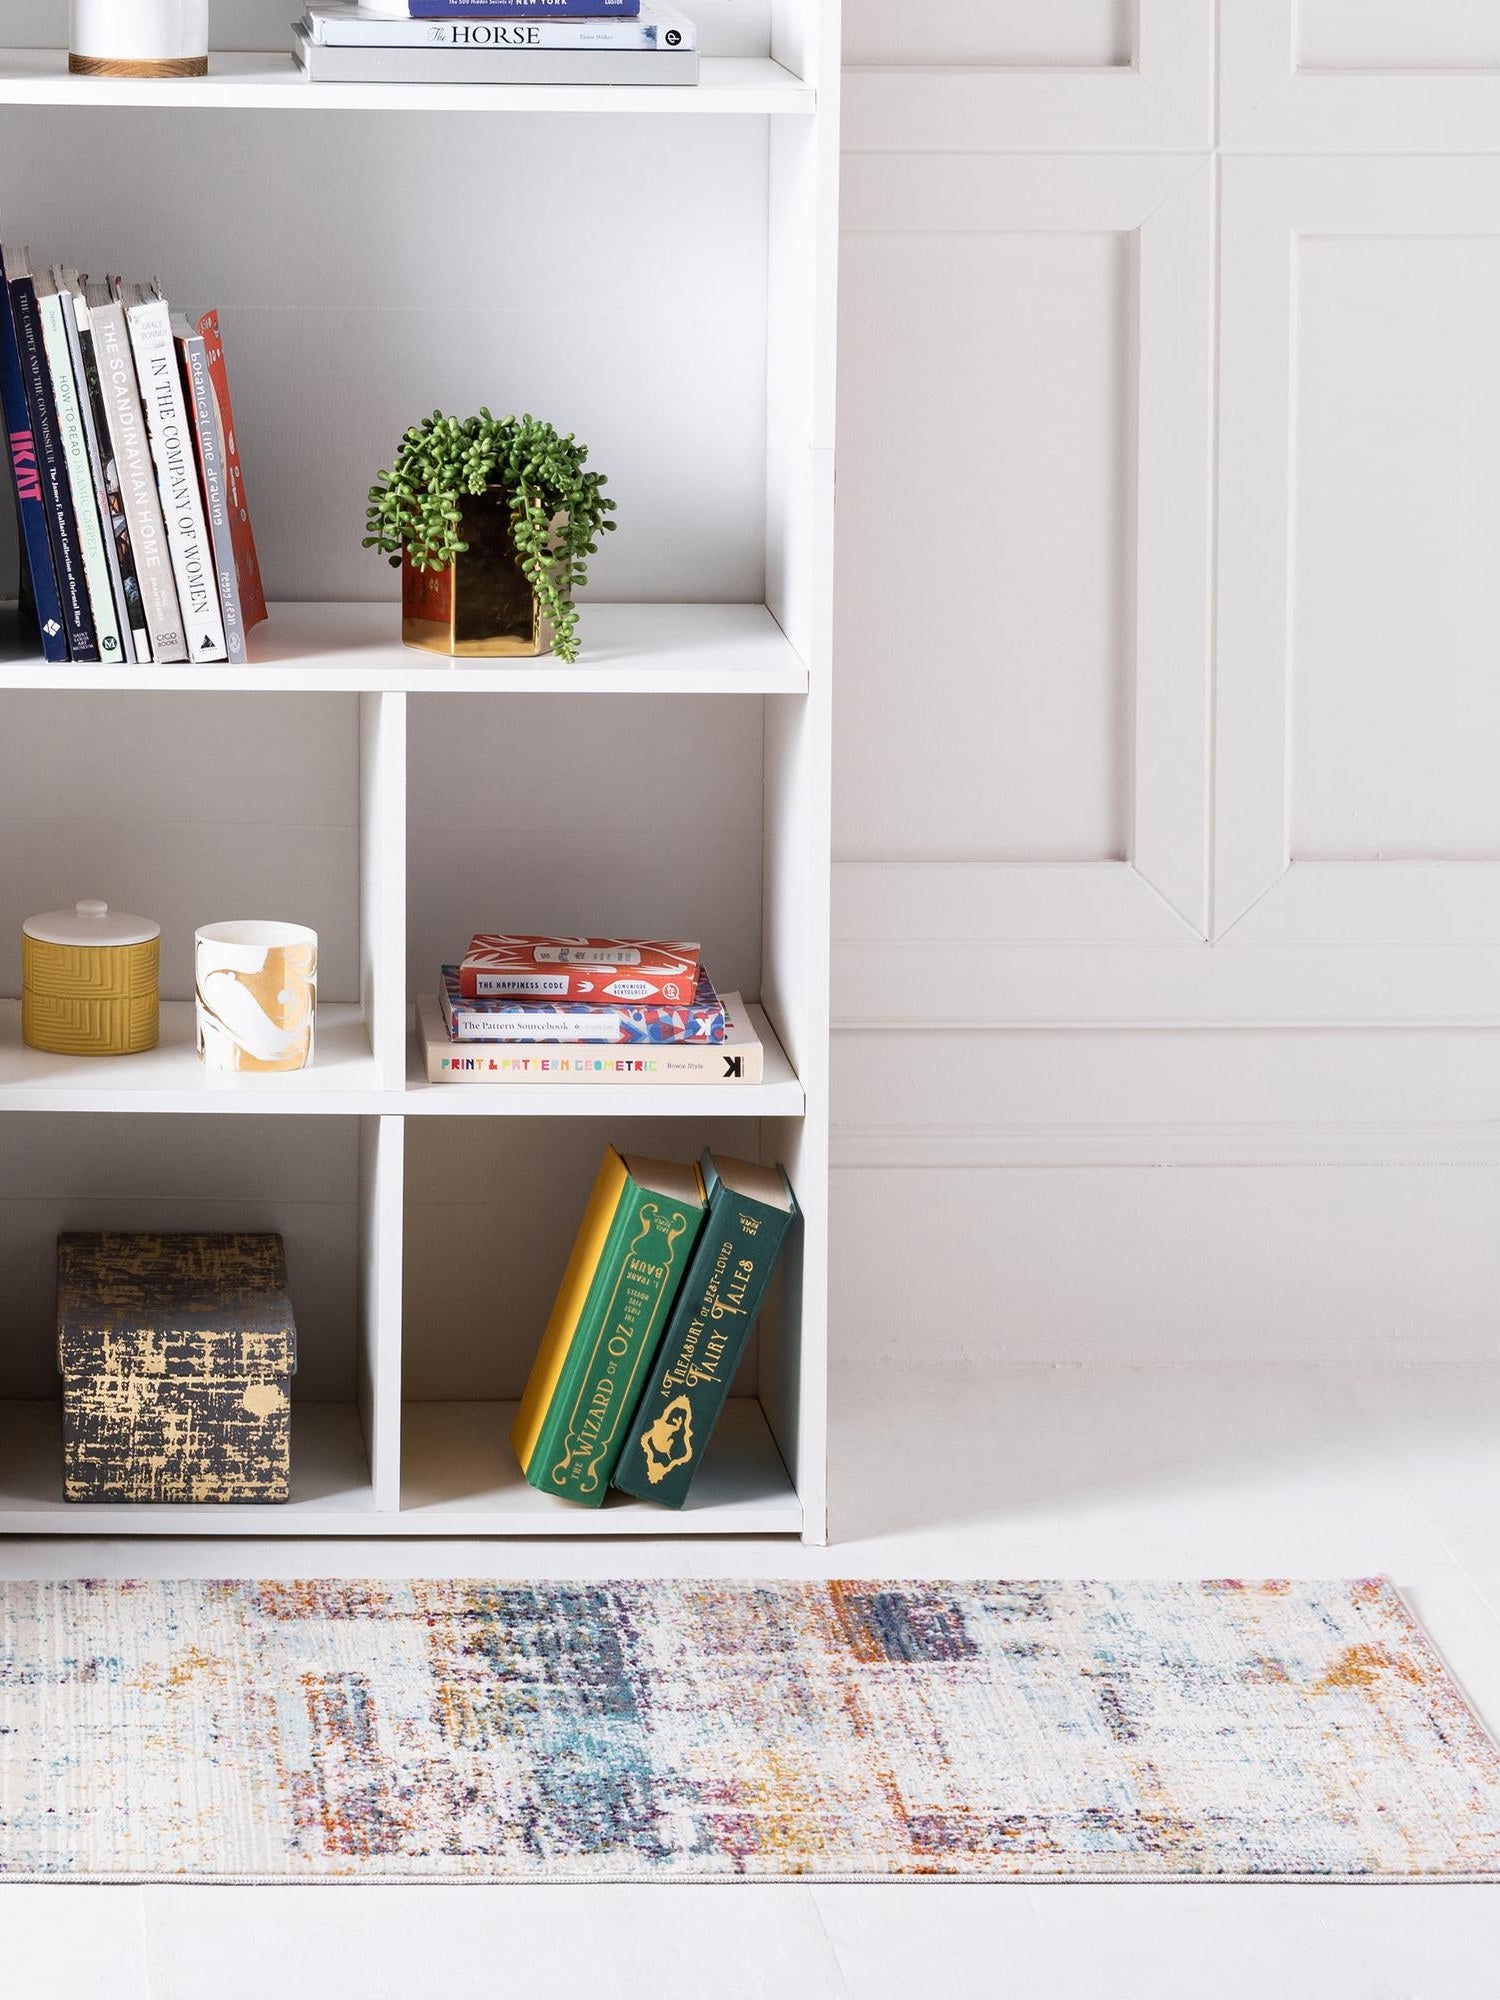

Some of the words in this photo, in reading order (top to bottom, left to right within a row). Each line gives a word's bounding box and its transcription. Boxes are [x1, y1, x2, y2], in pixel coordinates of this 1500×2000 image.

[427, 27, 447, 42] The
[451, 26, 541, 45] HORSE
[20, 292, 30, 314] THE
[23, 316, 36, 352] CARPET
[103, 322, 118, 353] THE
[29, 354, 40, 374] AND
[150, 357, 169, 376] IN
[34, 376, 43, 397] THE
[60, 375, 72, 402] HOW
[191, 352, 211, 425] botanical
[155, 381, 176, 420] THE
[65, 407, 75, 422] TO
[37, 398, 56, 464] CONNOISSEUR
[68, 426, 80, 456] READ
[110, 359, 149, 505] SCANDINAVIAN
[202, 431, 214, 461] line
[10, 430, 42, 501] IKAT
[49, 467, 58, 481] The
[162, 425, 192, 511] COMPANY
[52, 482, 60, 503] James
[73, 459, 91, 507] ISLAMIC
[207, 468, 223, 526] drawing
[57, 512, 68, 537] Ballard
[83, 511, 100, 558] CARPETS
[178, 517, 197, 539] OF
[137, 511, 160, 568] HOME
[61, 538, 72, 572] Collection
[183, 544, 210, 613] WOMEN
[221, 572, 233, 599] peggy
[69, 582, 80, 609] Oriental
[225, 601, 237, 626] dean
[157, 631, 177, 641] CICO
[158, 639, 179, 648] BOOKS
[479, 981, 493, 990] THE
[496, 981, 540, 990] HAPPINESS
[543, 982, 564, 990] CODE
[462, 1021, 480, 1030] The
[482, 1021, 515, 1031] Pattern
[517, 1021, 569, 1031] Sourcebook
[441, 1058, 484, 1071] PRINT
[488, 1058, 498, 1071] &
[502, 1059, 570, 1071] PATTERN
[574, 1060, 657, 1072] GEOMETRIC
[687, 1062, 704, 1071] Style
[626, 1272, 650, 1285] FRANK
[630, 1258, 664, 1279] BAUM
[627, 1288, 650, 1301] NOVELS
[662, 1318, 704, 1389] TREASURY
[704, 1241, 733, 1303] BEST-LOVED
[685, 1329, 728, 1388] FAIRY
[710, 1259, 754, 1320] TALES
[572, 1378, 614, 1457] WIZARD
[571, 1462, 583, 1479] THE
